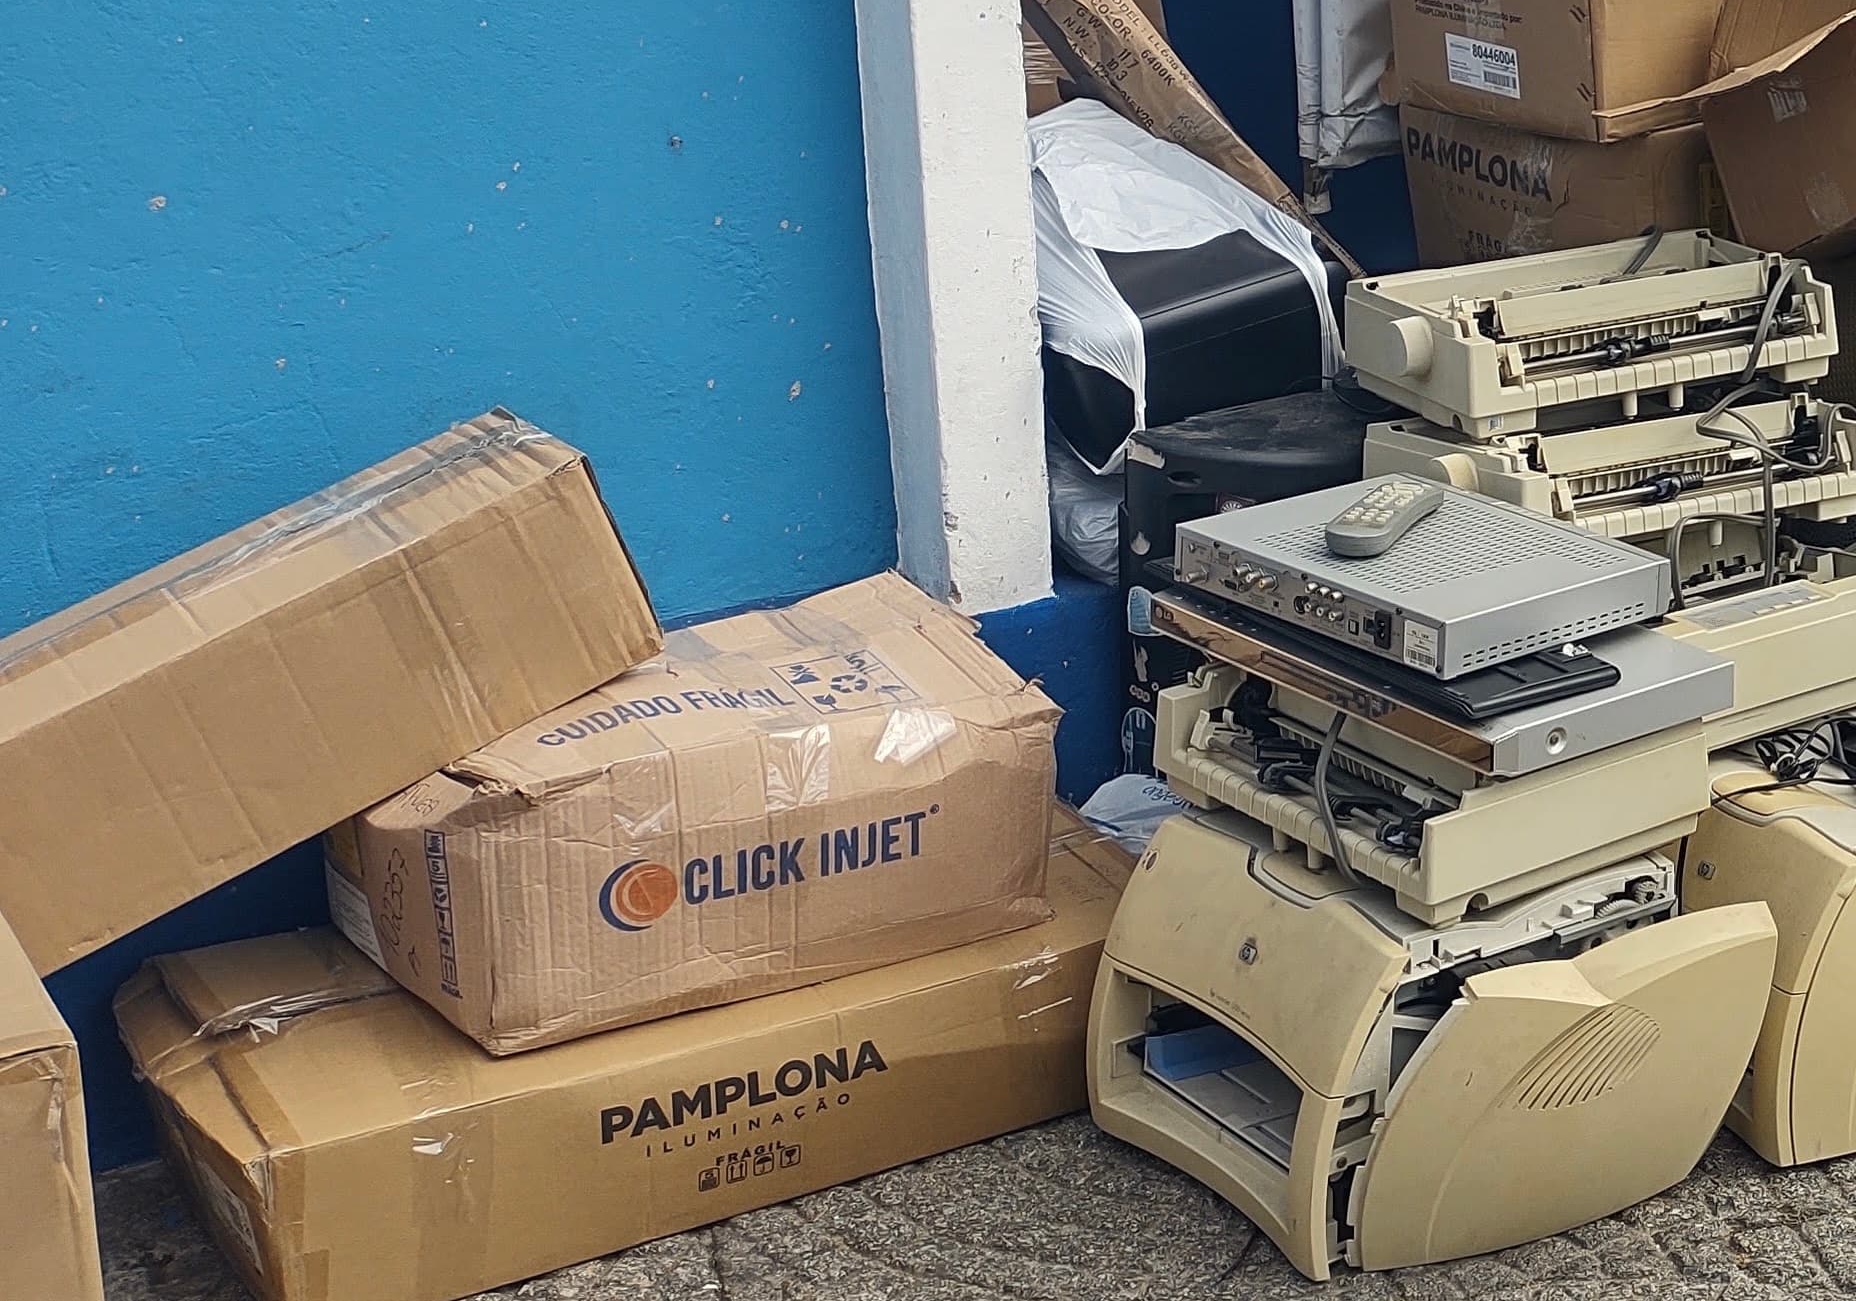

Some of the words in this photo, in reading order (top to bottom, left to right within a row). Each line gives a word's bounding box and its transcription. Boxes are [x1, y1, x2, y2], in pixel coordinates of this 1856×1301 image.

[1141, 49, 1175, 88] 6400K
[1472, 44, 1516, 66] 80446004
[1406, 127, 1553, 202] PAMPLONA
[536, 694, 684, 747] CUIDADO
[680, 687, 796, 711] FRÁGIL
[684, 836, 806, 906] CLICK
[819, 810, 927, 877] INJET
[600, 1039, 889, 1145] PAMPLONA
[645, 1093, 851, 1158] ILUMINAÇÃO
